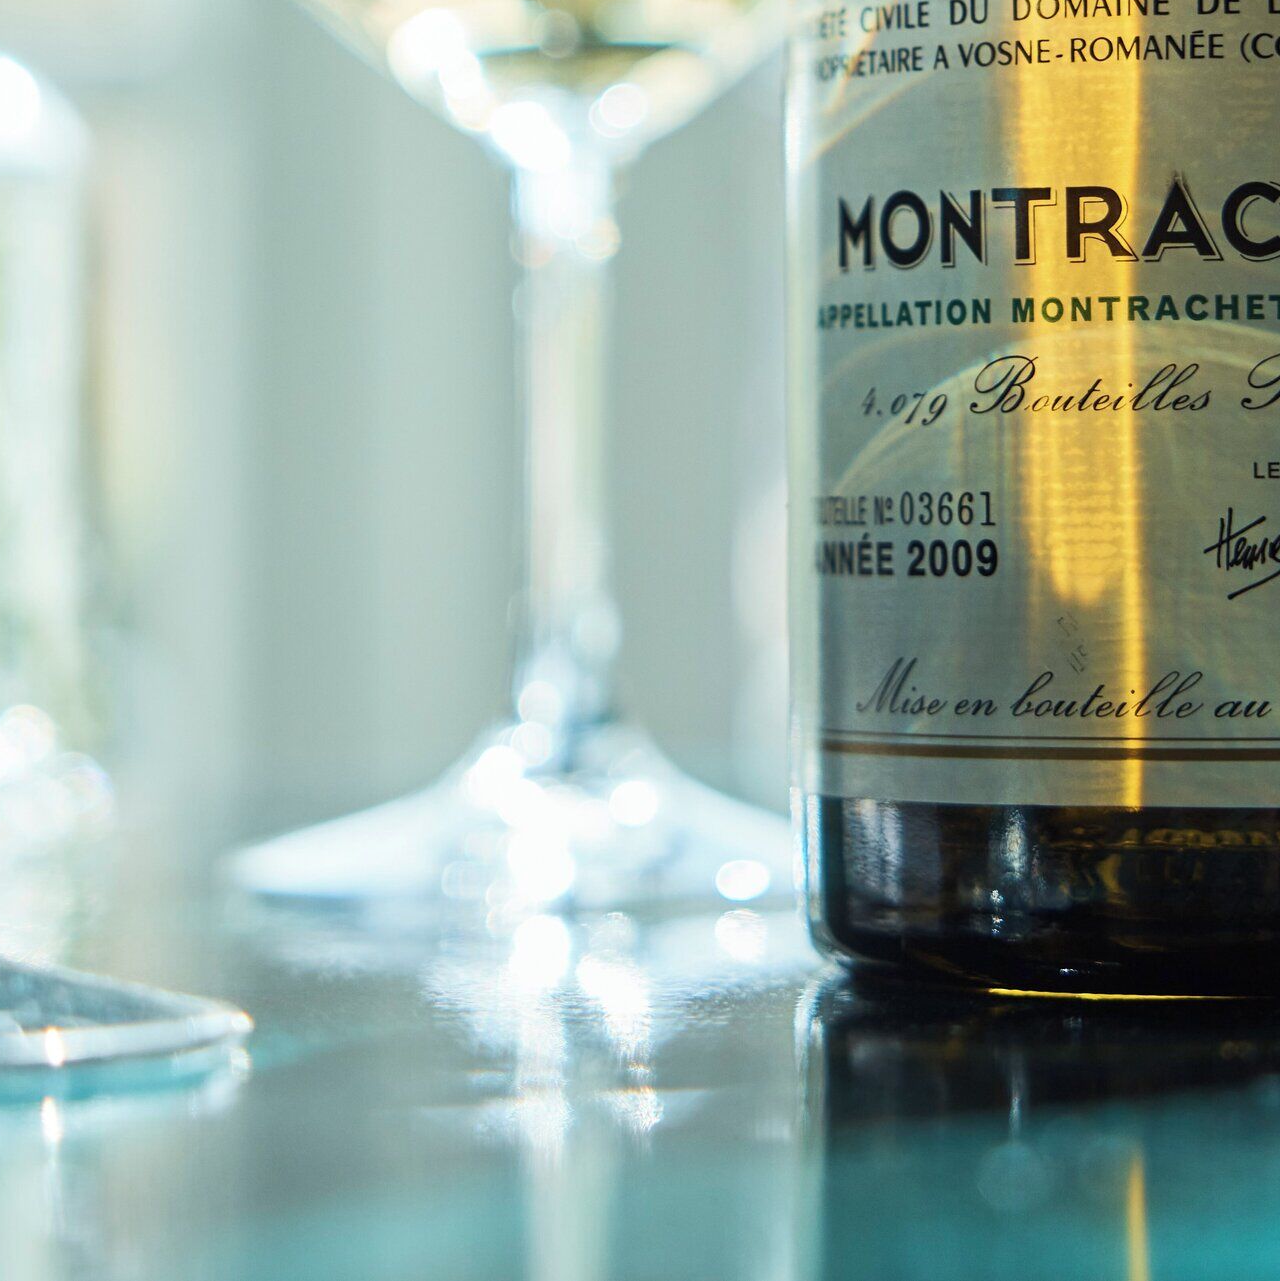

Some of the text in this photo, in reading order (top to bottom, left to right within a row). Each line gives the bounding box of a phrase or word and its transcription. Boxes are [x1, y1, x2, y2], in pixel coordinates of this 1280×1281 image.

[860, 0, 930, 34] CIVILE
[933, 44, 950, 71] A
[958, 30, 1225, 67] VOSNE-ROMANÉE
[861, 386, 948, 426] 4.079
[969, 355, 1212, 414] Bouteilles
[900, 491, 997, 526] 03661
[907, 538, 999, 577] 2009
[856, 657, 948, 718] Mise
[954, 696, 998, 718] en
[1010, 671, 1204, 719] bouteille
[1214, 697, 1272, 719] au
